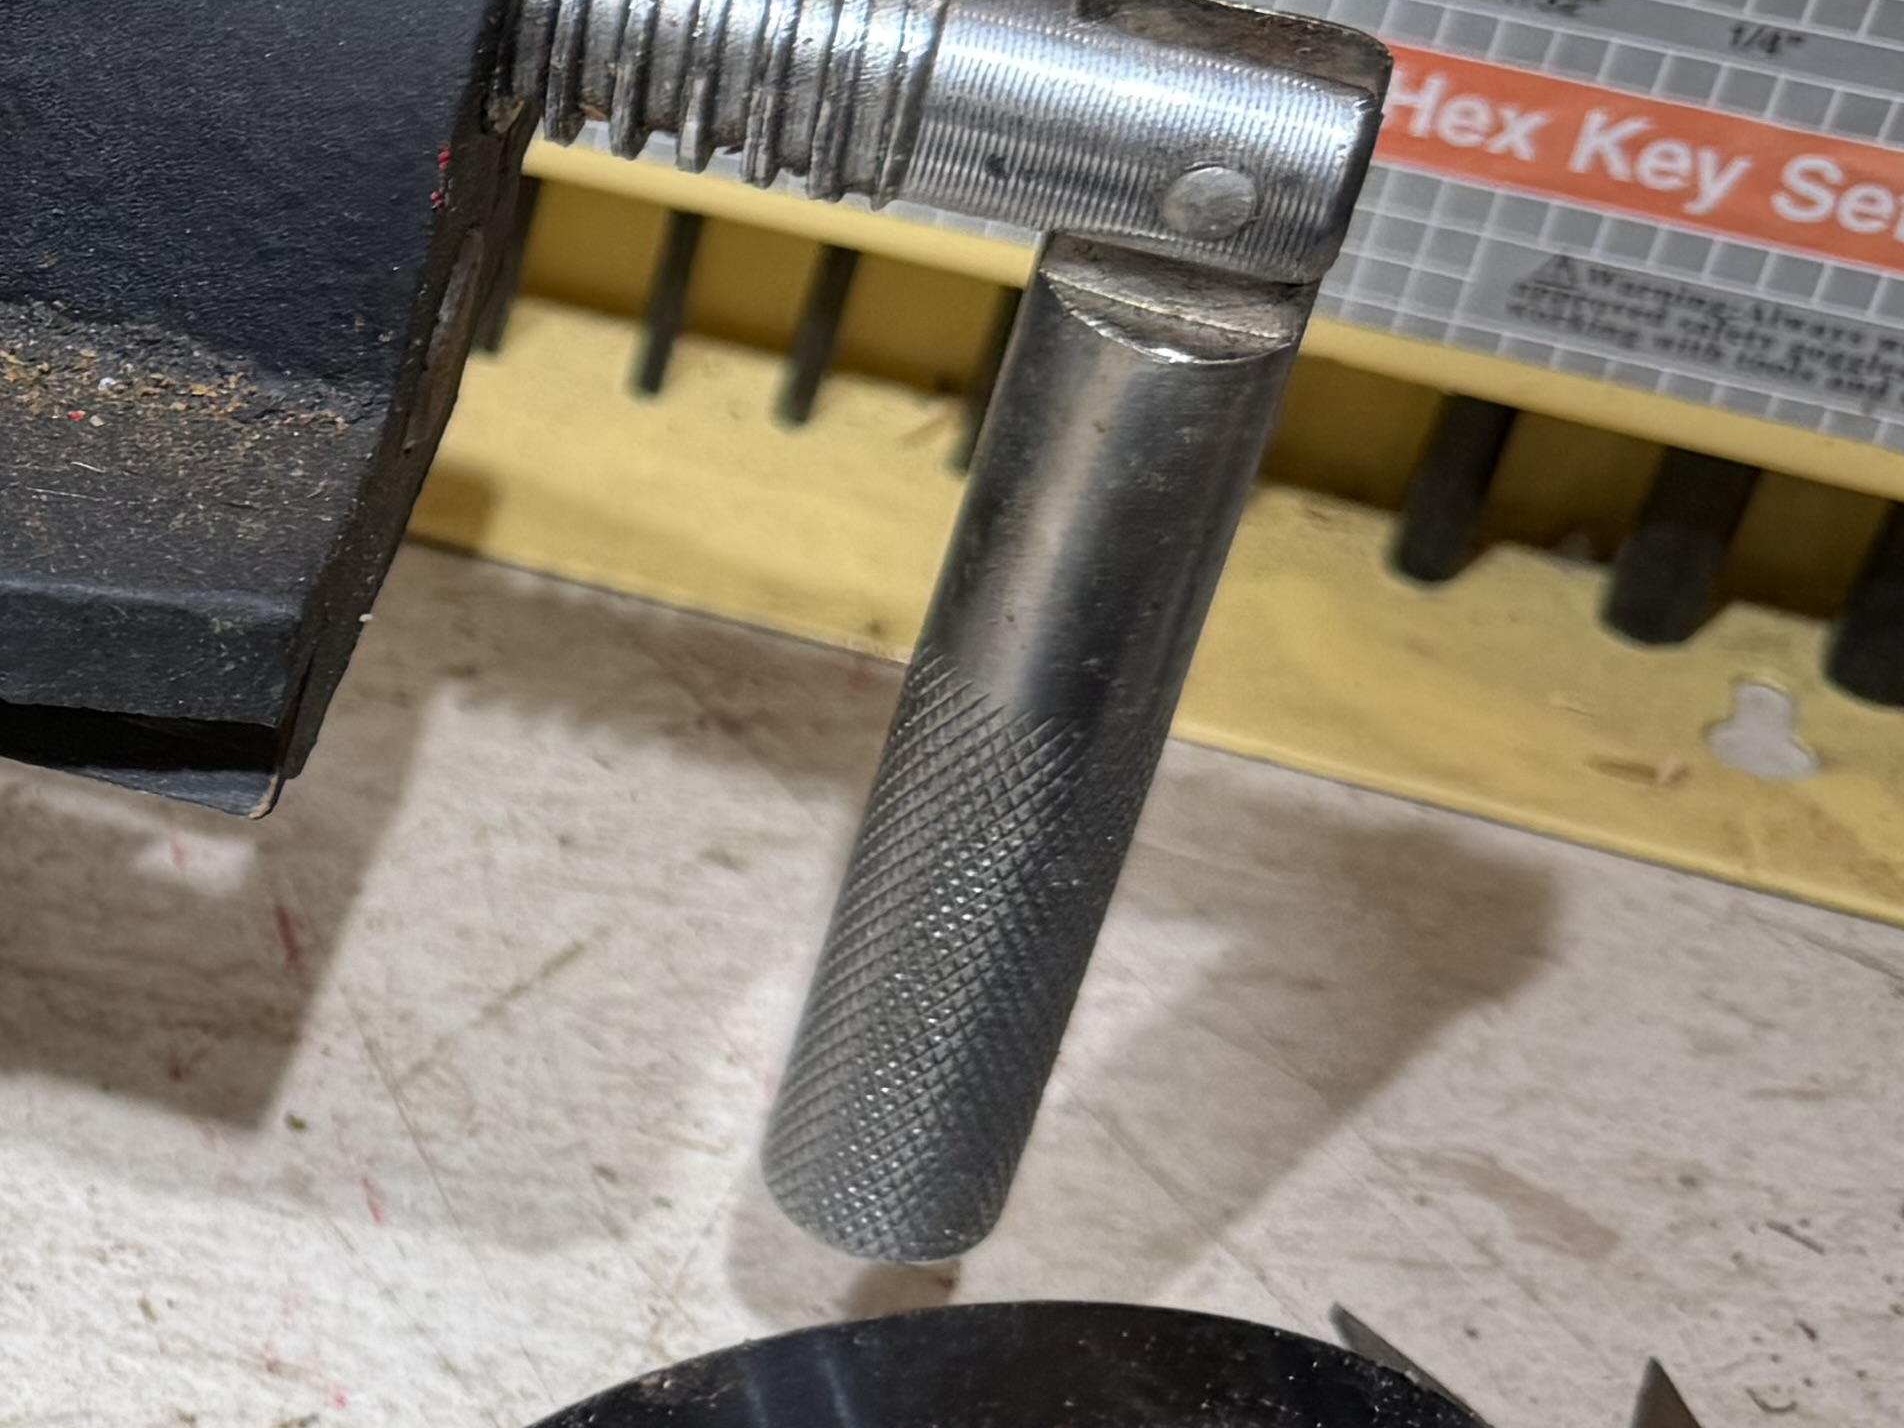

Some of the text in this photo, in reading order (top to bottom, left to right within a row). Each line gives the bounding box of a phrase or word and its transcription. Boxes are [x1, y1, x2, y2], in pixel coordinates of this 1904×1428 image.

[1728, 24, 1807, 59] 1/4"
[1383, 68, 1553, 162] Hex
[1568, 108, 1753, 215] Key
